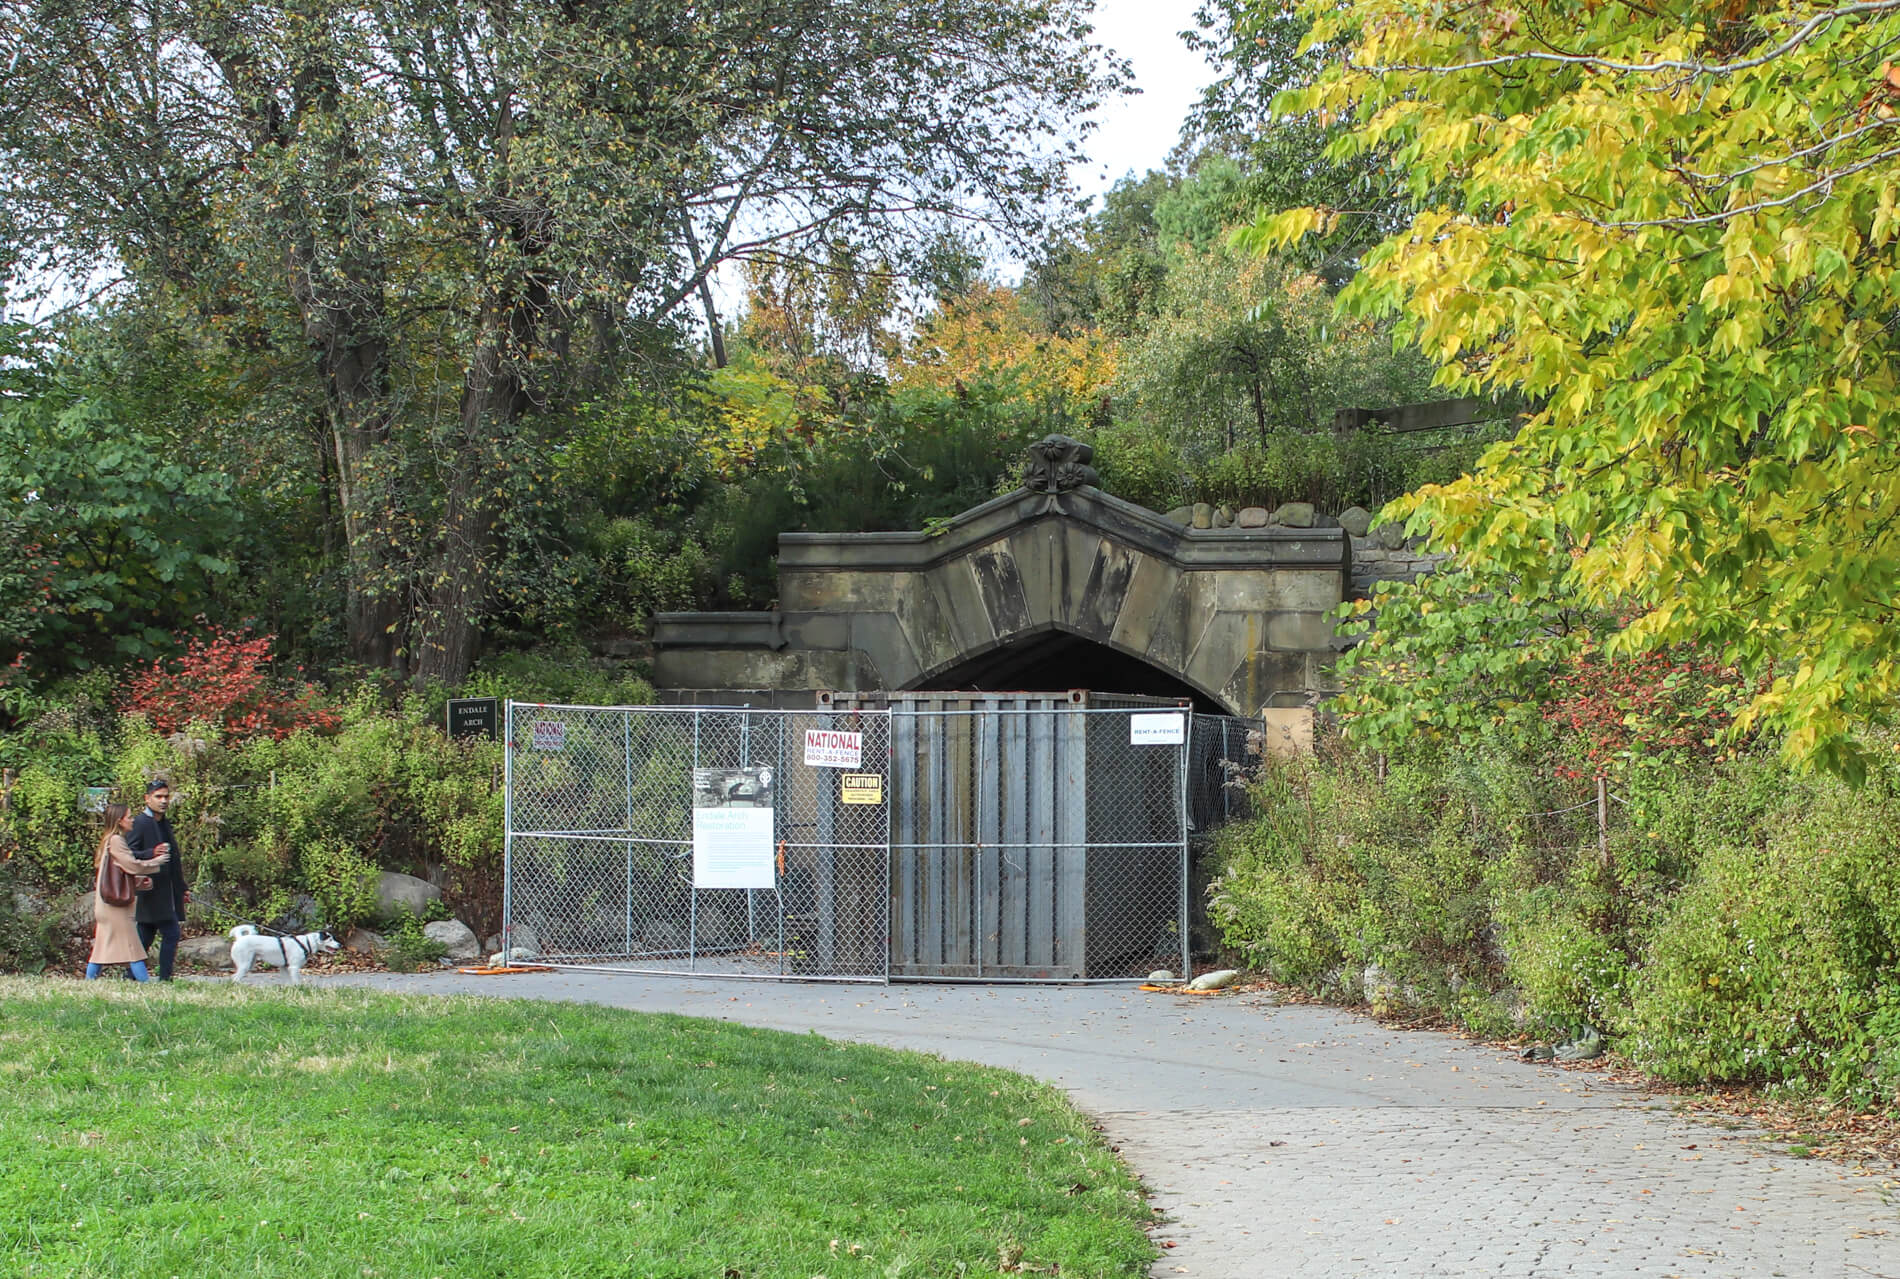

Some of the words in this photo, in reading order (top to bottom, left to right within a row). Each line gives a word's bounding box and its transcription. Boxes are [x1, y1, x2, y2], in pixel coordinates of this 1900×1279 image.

[458, 706, 488, 714] ENDALE
[463, 719, 483, 727] ARCH
[807, 732, 860, 750] NATIONAL
[807, 748, 859, 757] RENT-A-FENCE
[806, 754, 860, 764] 800-352-5675
[846, 777, 879, 788] CAUTION
